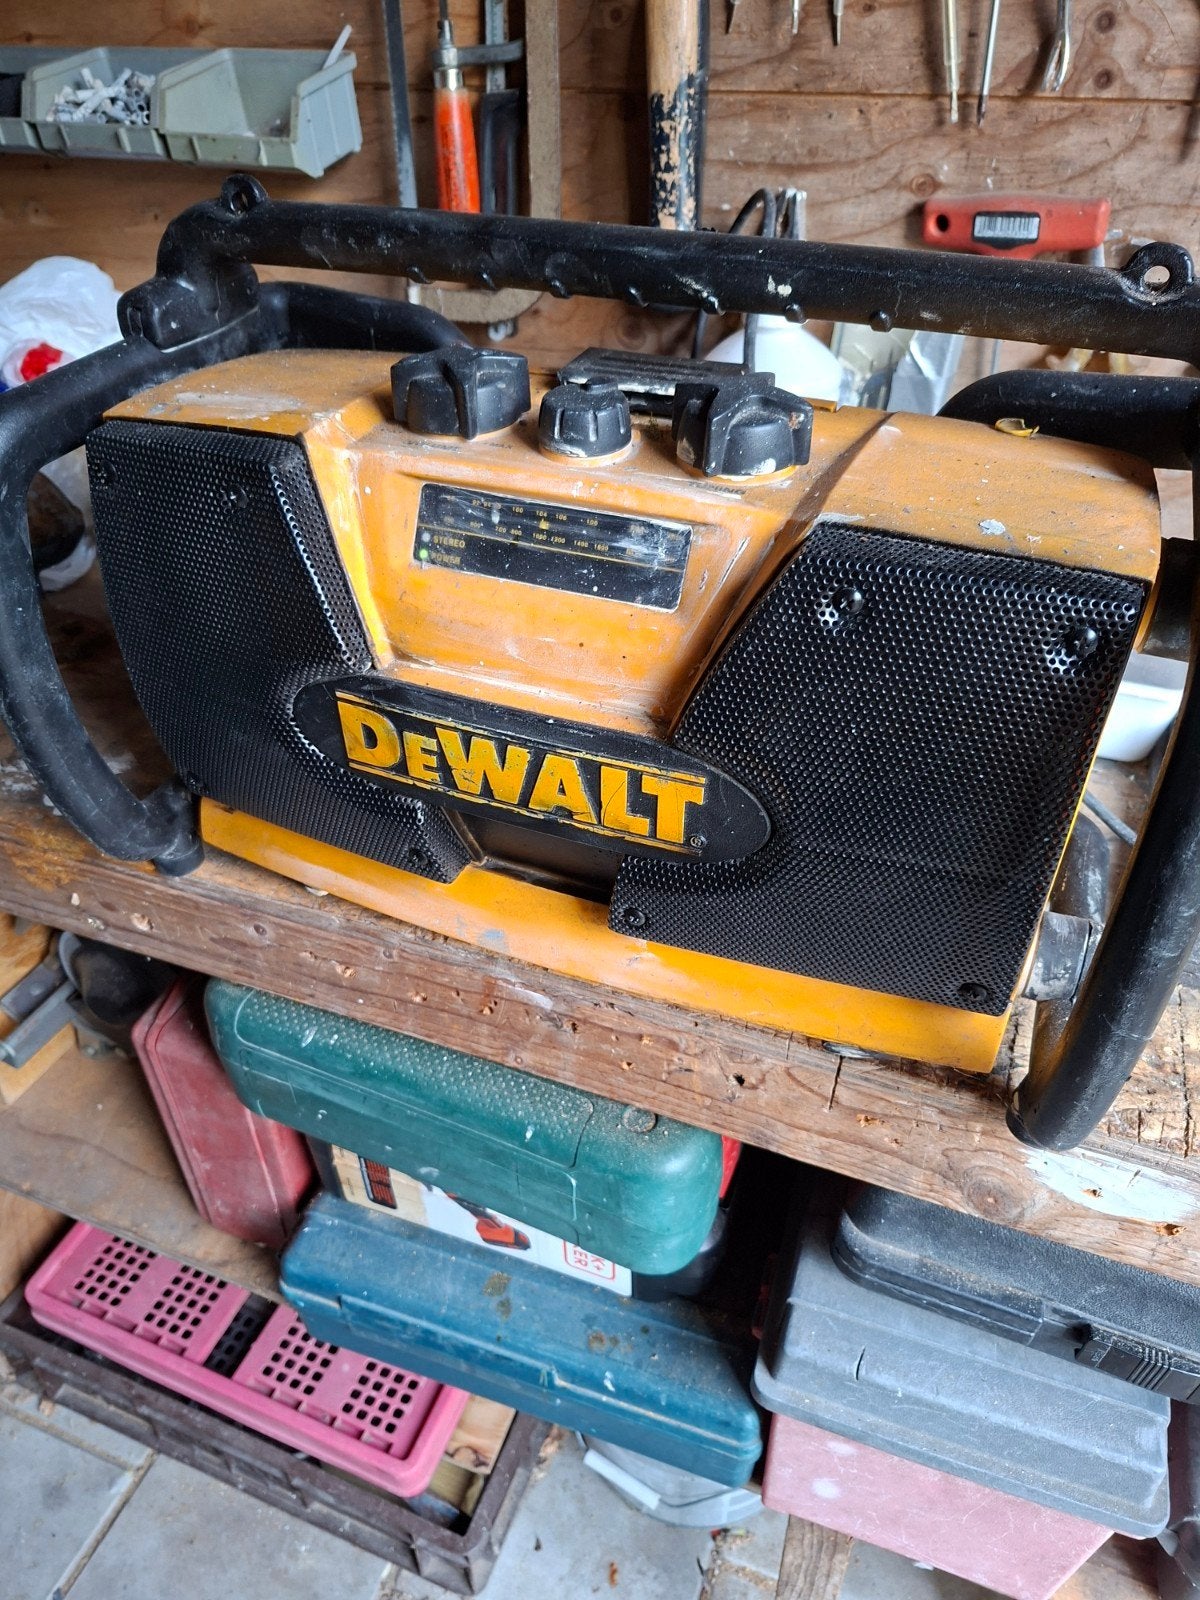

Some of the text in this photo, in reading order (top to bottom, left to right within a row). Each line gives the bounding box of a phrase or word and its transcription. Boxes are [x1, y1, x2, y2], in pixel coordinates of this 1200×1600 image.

[512, 506, 524, 514] 100
[536, 510, 548, 518] 104
[433, 535, 466, 548] STEREO
[550, 536, 566, 544] 1200
[573, 540, 589, 548] 1400
